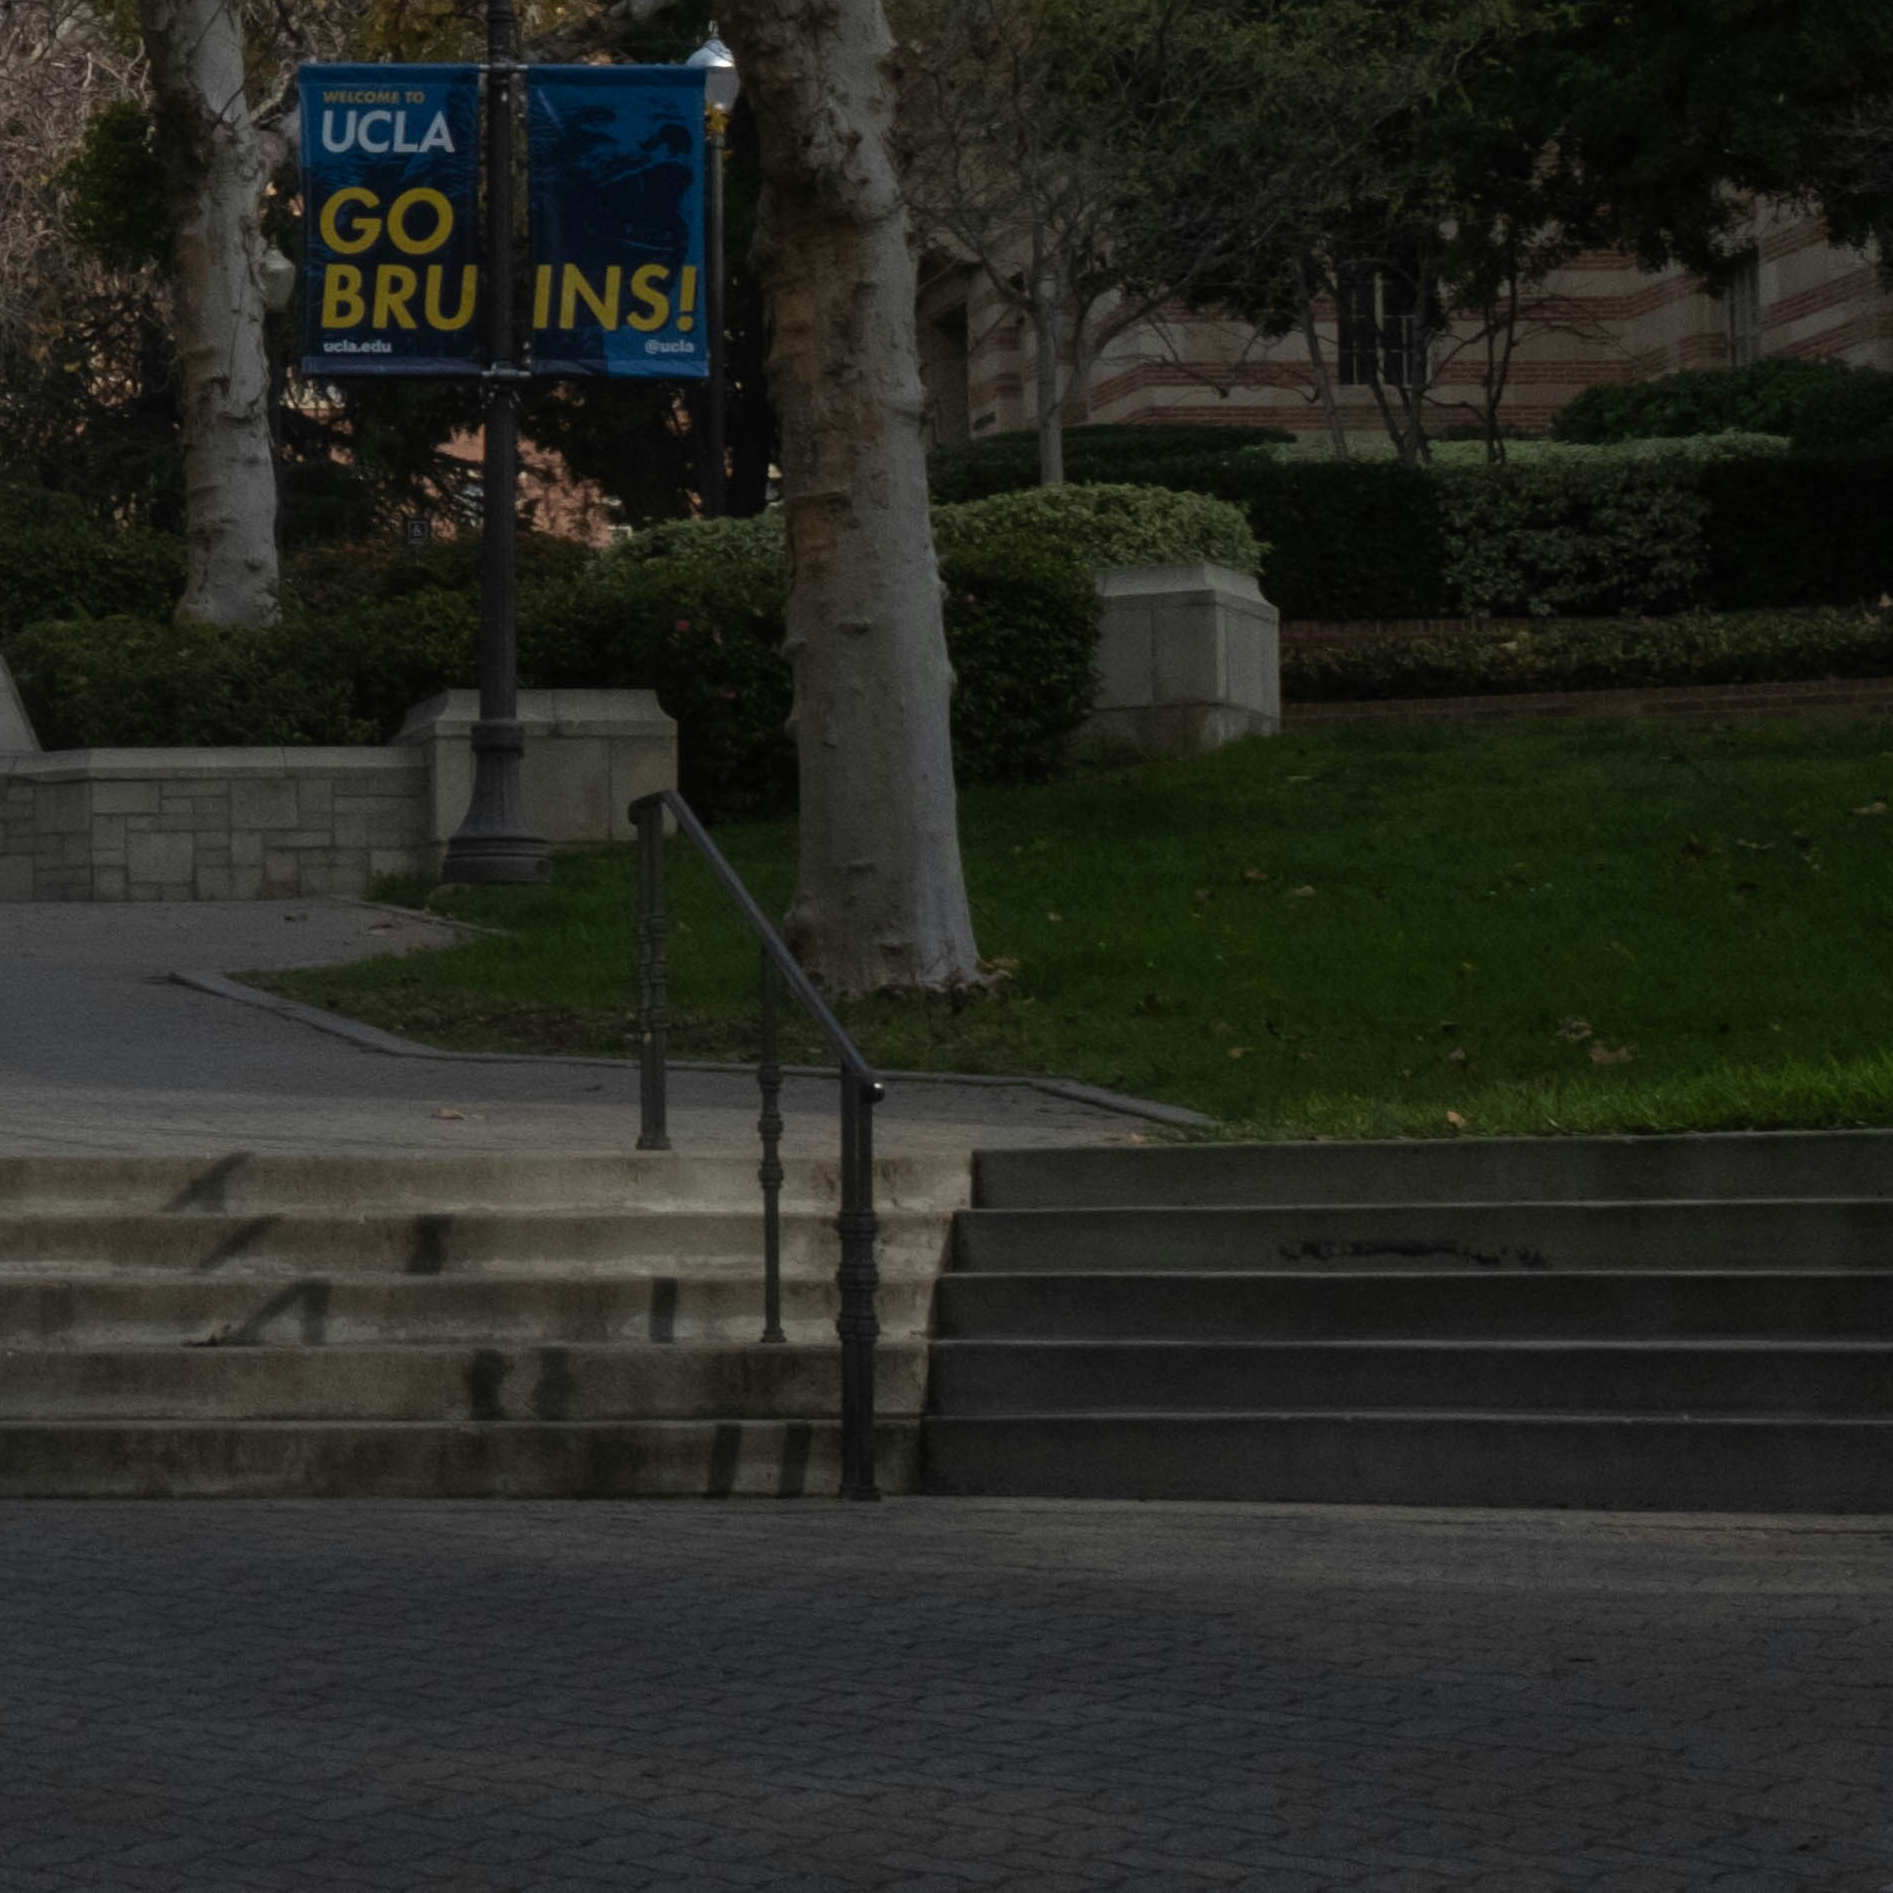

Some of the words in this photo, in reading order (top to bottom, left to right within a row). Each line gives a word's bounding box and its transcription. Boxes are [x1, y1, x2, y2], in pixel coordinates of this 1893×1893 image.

[322, 90, 399, 104] WELCOME
[404, 90, 426, 105] TO
[321, 109, 456, 154] UCLA
[319, 187, 455, 255] GO
[320, 264, 478, 331] BRU
[532, 263, 697, 332] INS!
[323, 339, 393, 354] ucla.edu
[644, 338, 696, 355] @ucla
